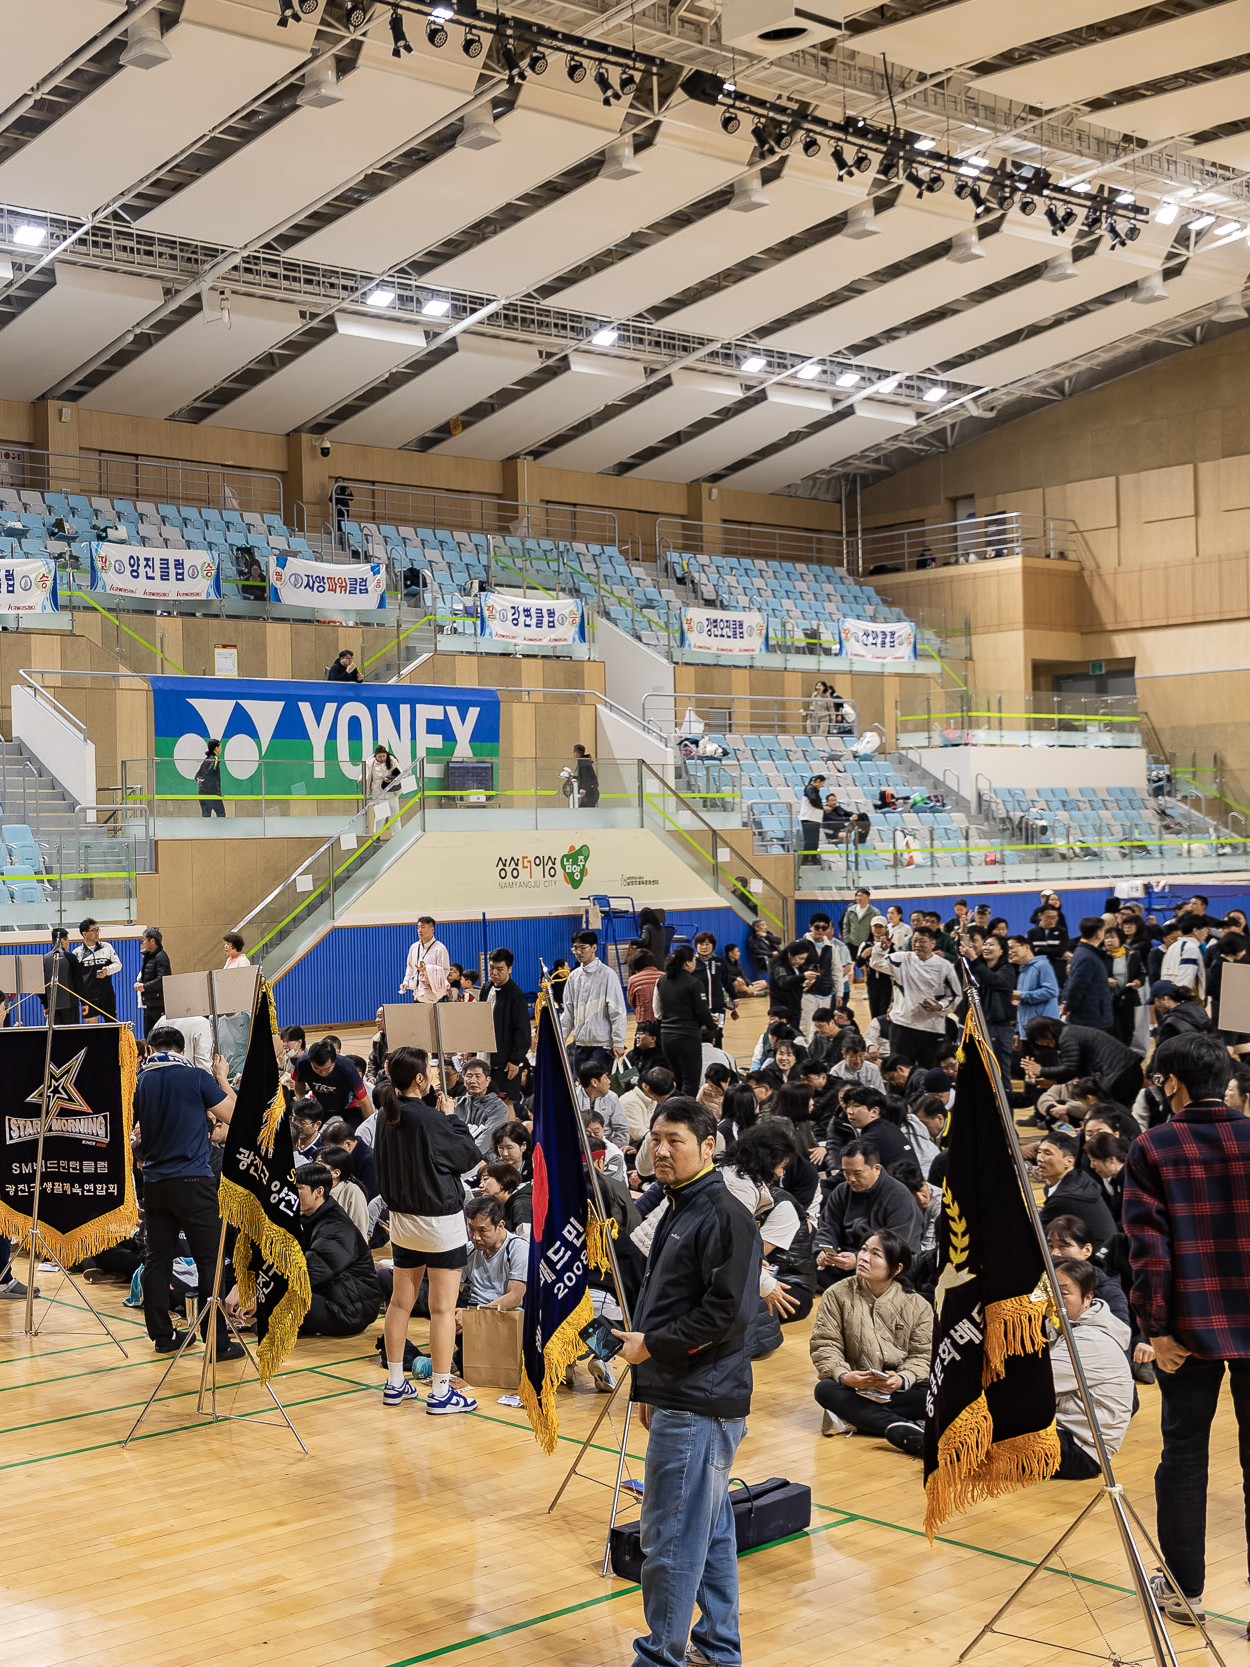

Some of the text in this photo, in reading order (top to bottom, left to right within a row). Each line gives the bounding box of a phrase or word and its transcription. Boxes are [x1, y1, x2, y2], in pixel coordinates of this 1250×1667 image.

[128, 554, 185, 582] 양진클럽
[204, 562, 214, 578] 승
[38, 573, 50, 589] 승
[304, 574, 369, 595] 자양파워클럽
[510, 605, 556, 629] 강변클럽
[298, 701, 480, 779] YONEX
[498, 880, 557, 889] NAMYANGJU CITY
[10, 1116, 105, 1139] STAR MORNING
[270, 1180, 300, 1217] 양진
